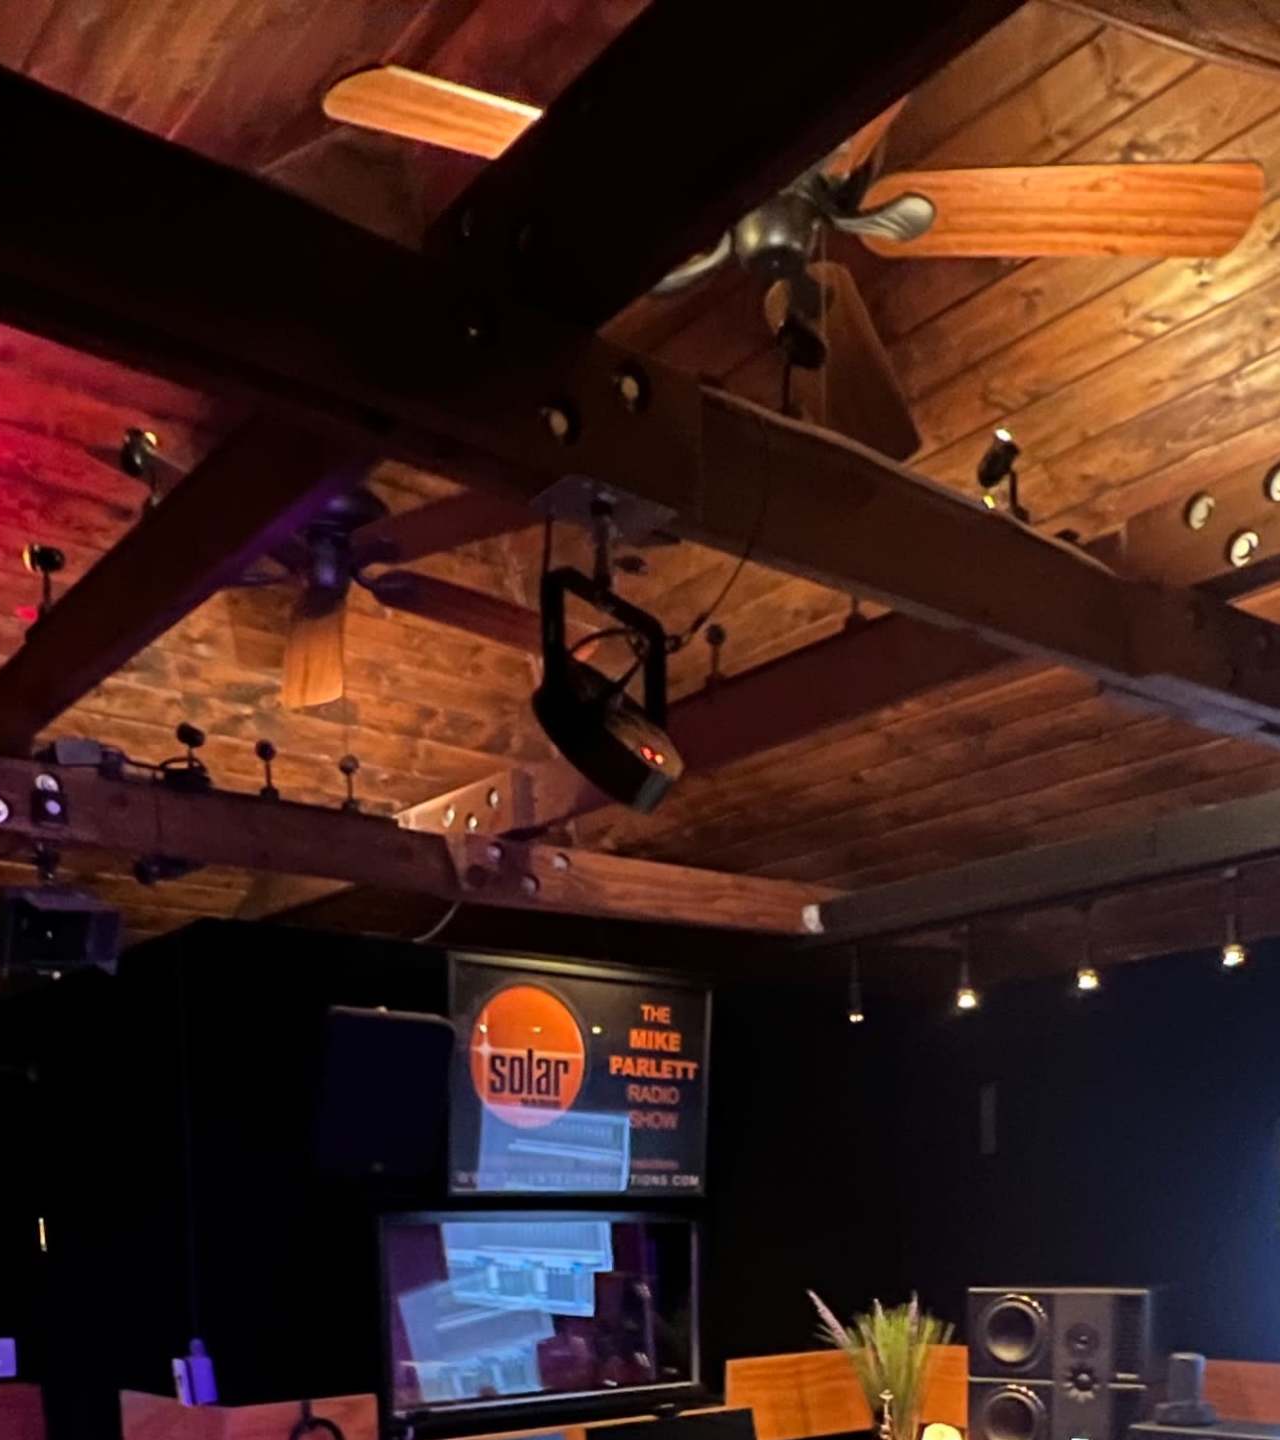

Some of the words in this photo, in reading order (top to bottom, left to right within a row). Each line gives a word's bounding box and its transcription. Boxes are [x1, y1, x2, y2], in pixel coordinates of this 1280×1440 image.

[641, 1005, 671, 1024] THE
[630, 1030, 681, 1053] MIKE
[490, 1048, 570, 1097] solar
[610, 1056, 698, 1080] PARLETT
[629, 1085, 679, 1105] RADIO
[629, 1110, 678, 1129] SHOW
